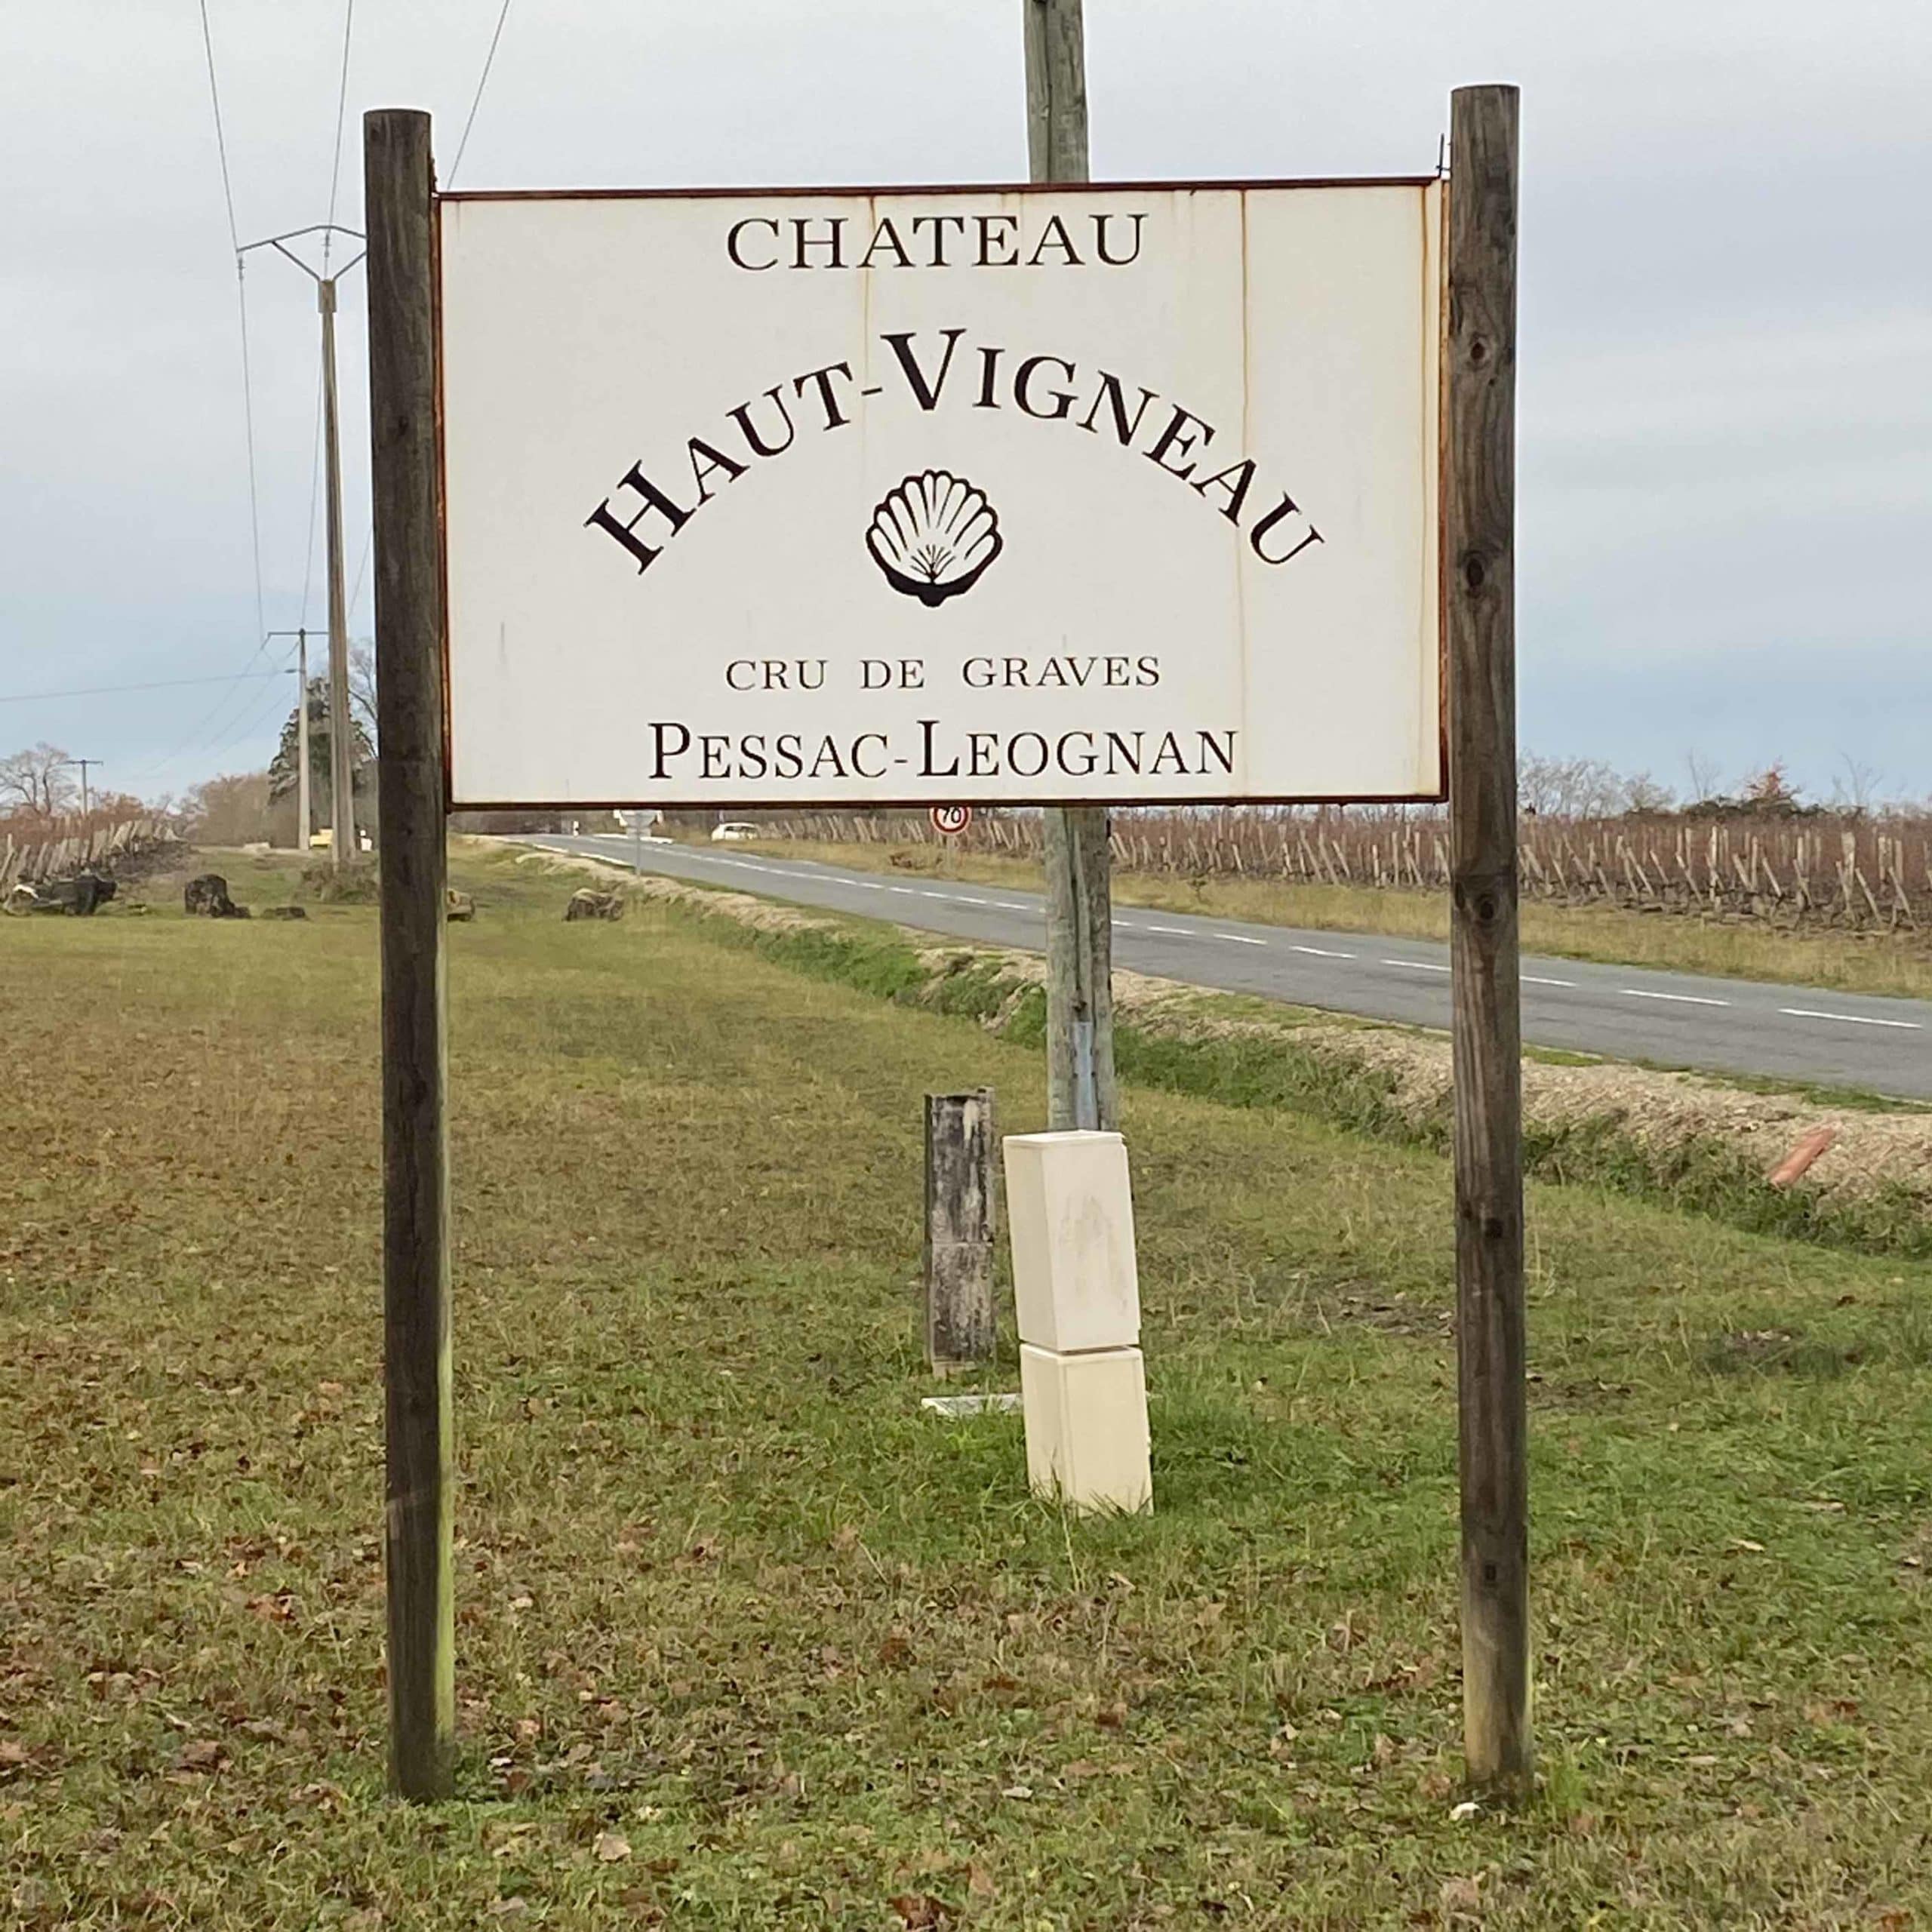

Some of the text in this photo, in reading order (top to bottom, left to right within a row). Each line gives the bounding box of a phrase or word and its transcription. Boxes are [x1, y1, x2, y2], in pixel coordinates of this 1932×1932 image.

[728, 214, 1147, 270] CHATEAU
[726, 657, 1159, 690] CRU DE GRAVES
[943, 807, 962, 823] 70
